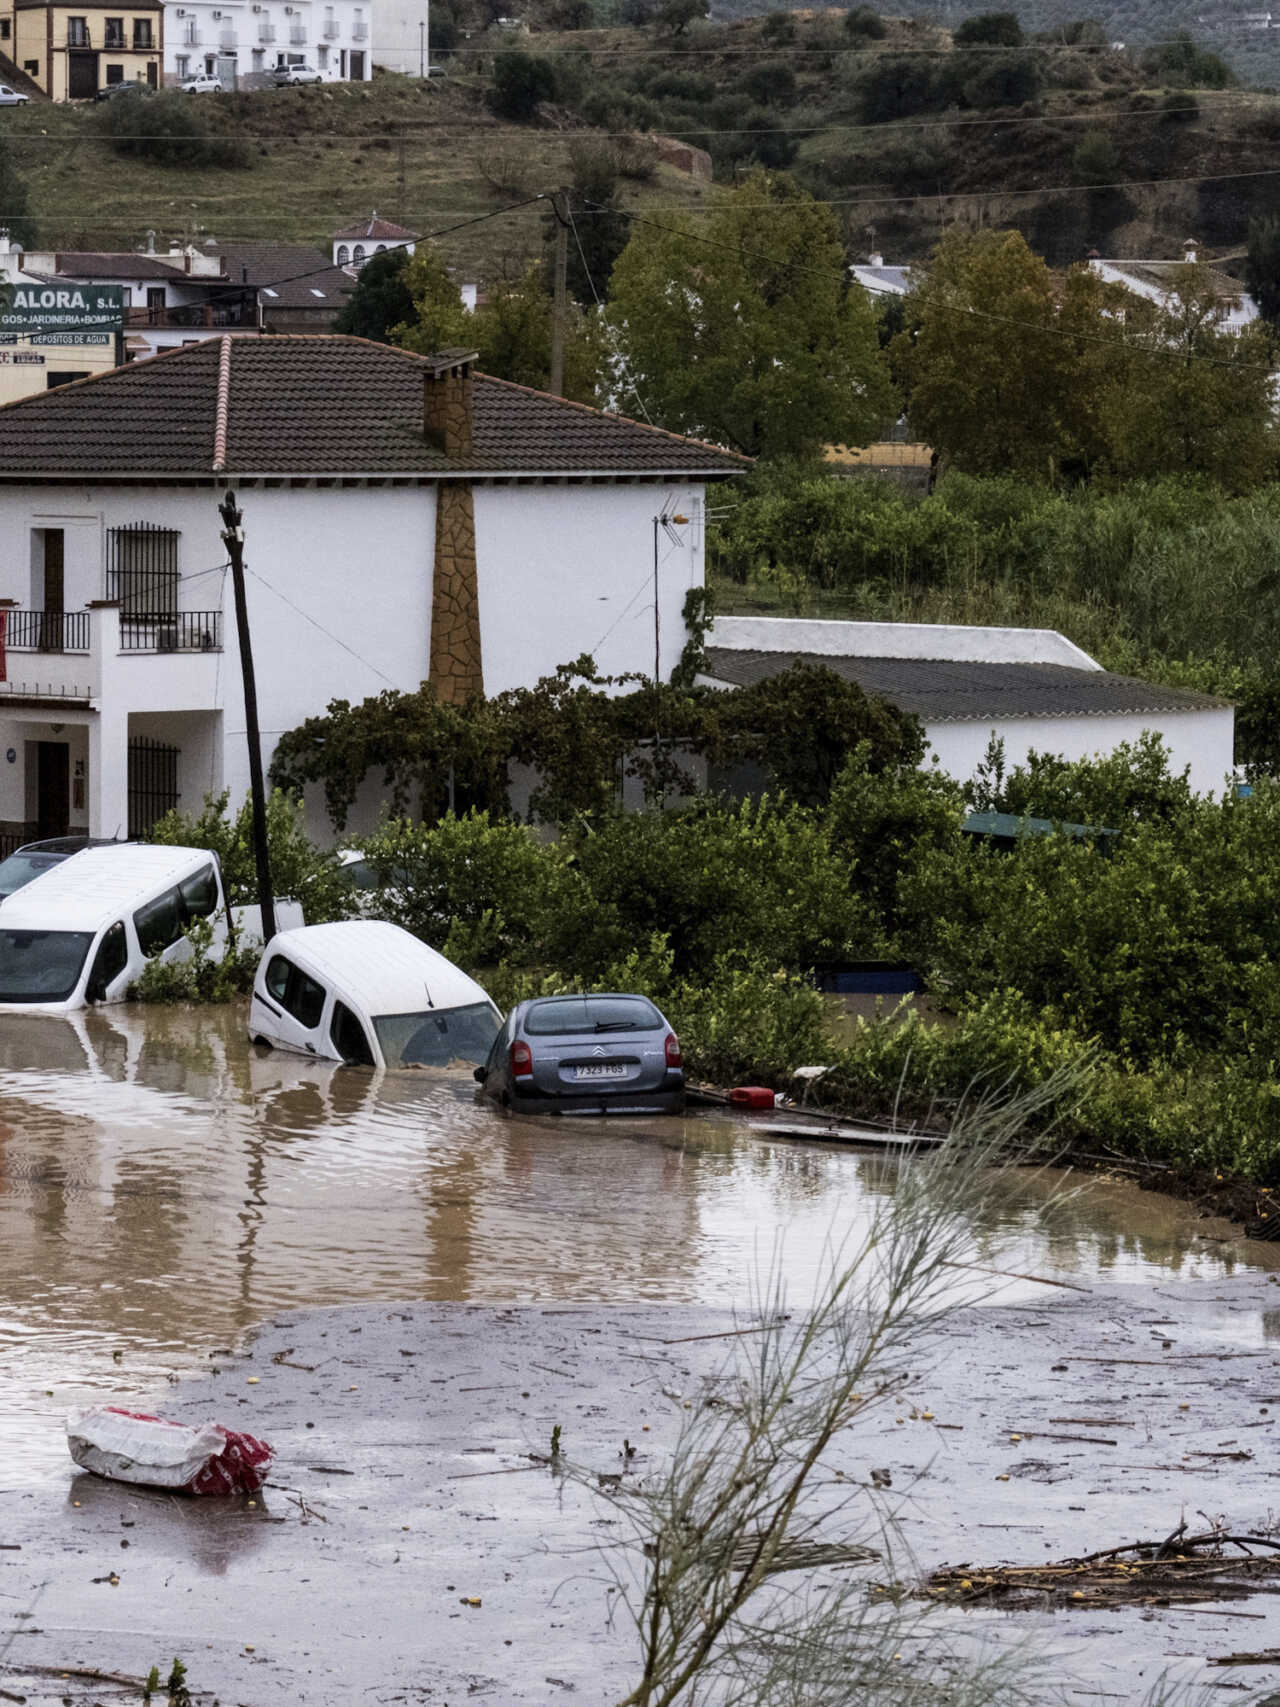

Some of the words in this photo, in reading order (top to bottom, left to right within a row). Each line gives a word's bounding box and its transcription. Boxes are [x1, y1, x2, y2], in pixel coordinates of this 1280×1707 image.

[12, 290, 91, 311] ALORA,
[96, 297, 121, 309] S.L.
[74, 335, 83, 344] DE
[86, 335, 107, 344] AGUA
